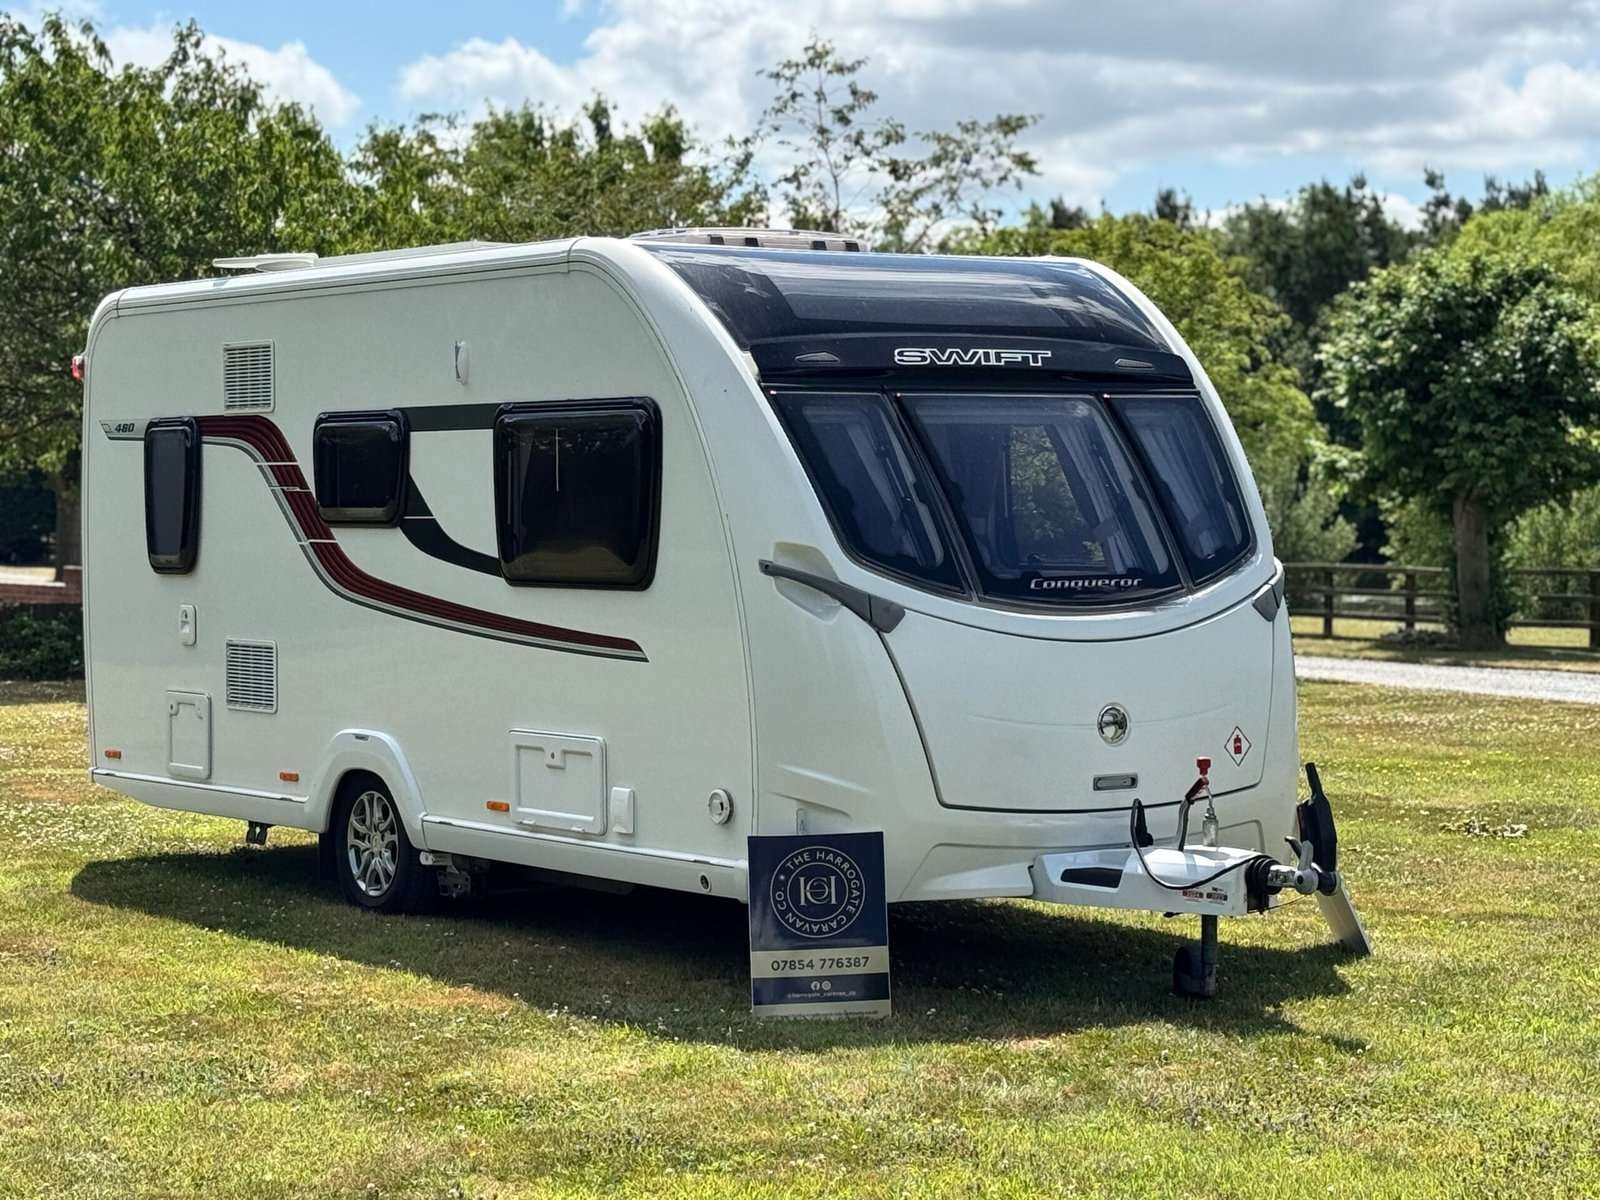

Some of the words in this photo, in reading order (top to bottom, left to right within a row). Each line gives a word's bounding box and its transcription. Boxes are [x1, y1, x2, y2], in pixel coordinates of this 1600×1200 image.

[894, 348, 1051, 366] SWIFT
[114, 422, 135, 432] 480
[1030, 578, 1143, 591] Conqueror
[785, 852, 811, 870] THE
[816, 851, 860, 914] HARROGATE
[785, 912, 847, 933] CARAVAN
[771, 959, 815, 972] 07854
[820, 956, 870, 970] 776387
